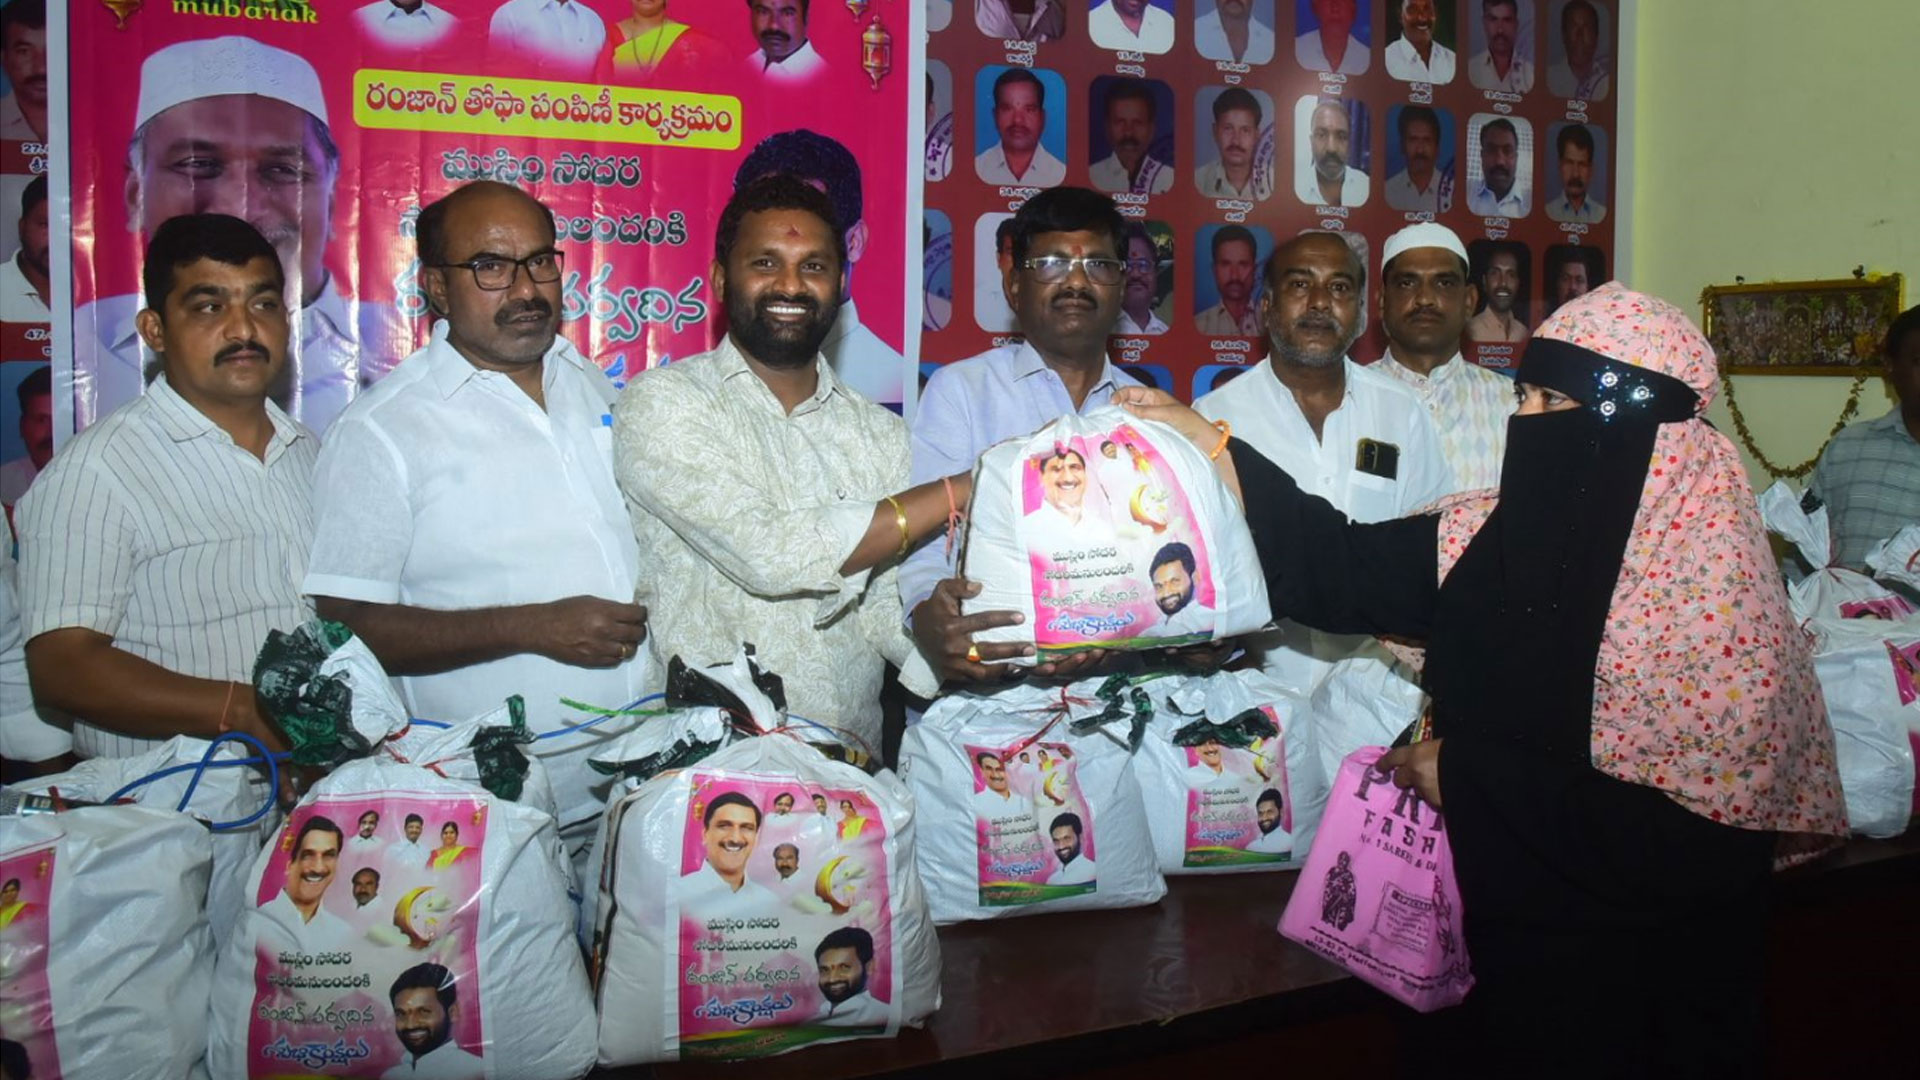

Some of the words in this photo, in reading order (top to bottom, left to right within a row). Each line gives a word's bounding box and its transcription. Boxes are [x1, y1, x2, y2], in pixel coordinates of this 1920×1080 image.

[172, 0, 319, 24] mubarak
[366, 81, 457, 115] రంజాన్
[463, 83, 525, 123] తోఫా
[530, 87, 613, 126] పంపిణీ
[618, 101, 734, 142] కార్యక్రమం
[553, 152, 641, 188] సోదర
